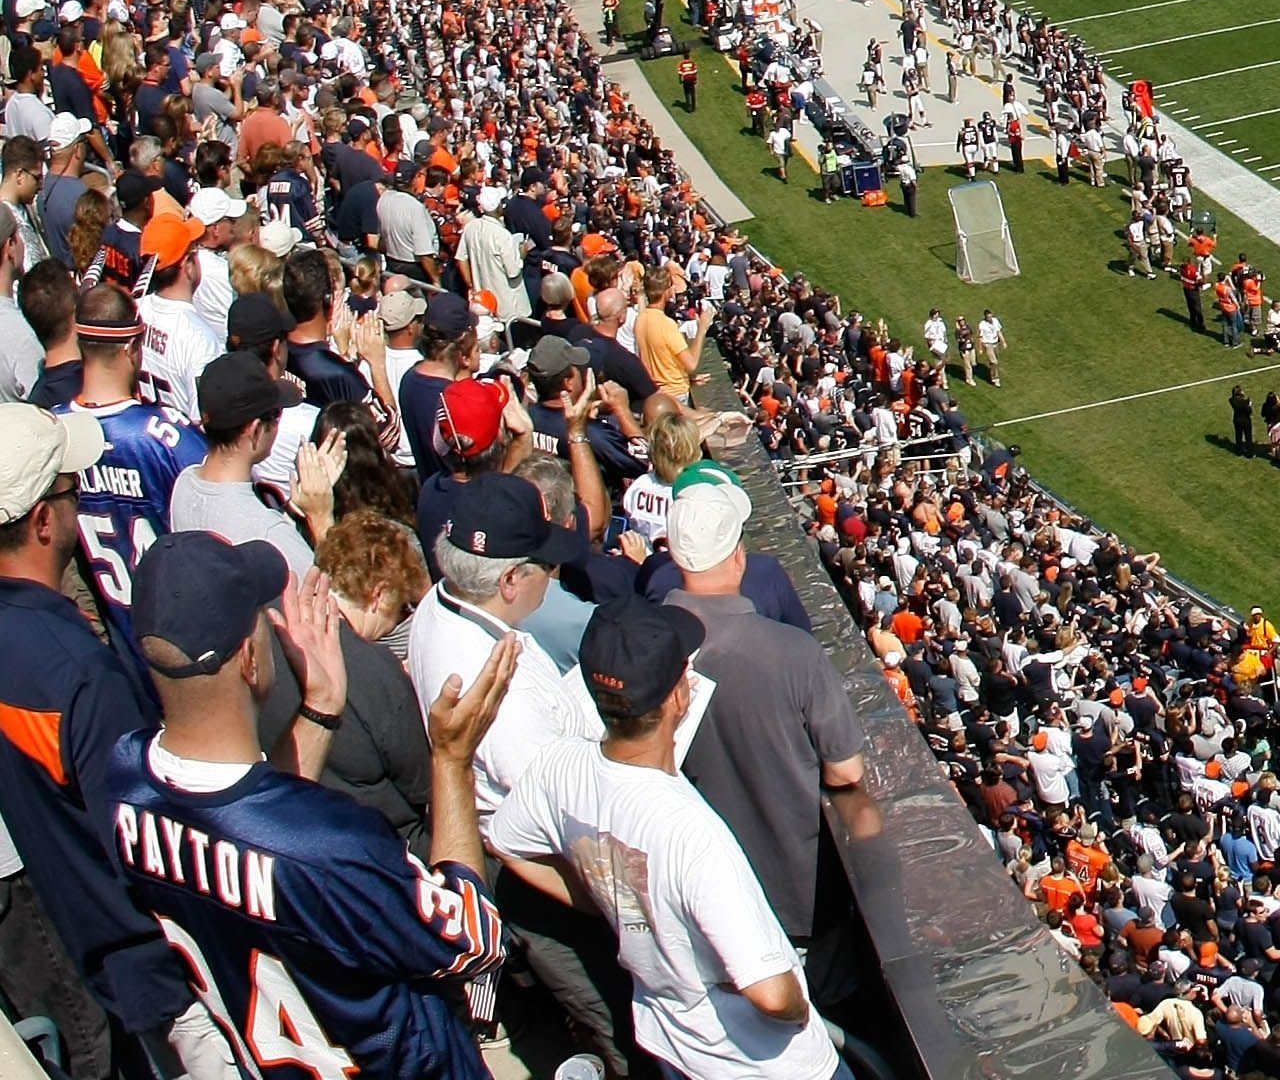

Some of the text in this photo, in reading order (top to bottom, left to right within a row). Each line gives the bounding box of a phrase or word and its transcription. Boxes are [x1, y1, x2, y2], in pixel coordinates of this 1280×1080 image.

[143, 322, 169, 356] IGGS
[147, 406, 192, 448] 54
[532, 430, 559, 457] KNOX
[637, 491, 669, 518] CUT
[116, 802, 277, 921] PAYTON
